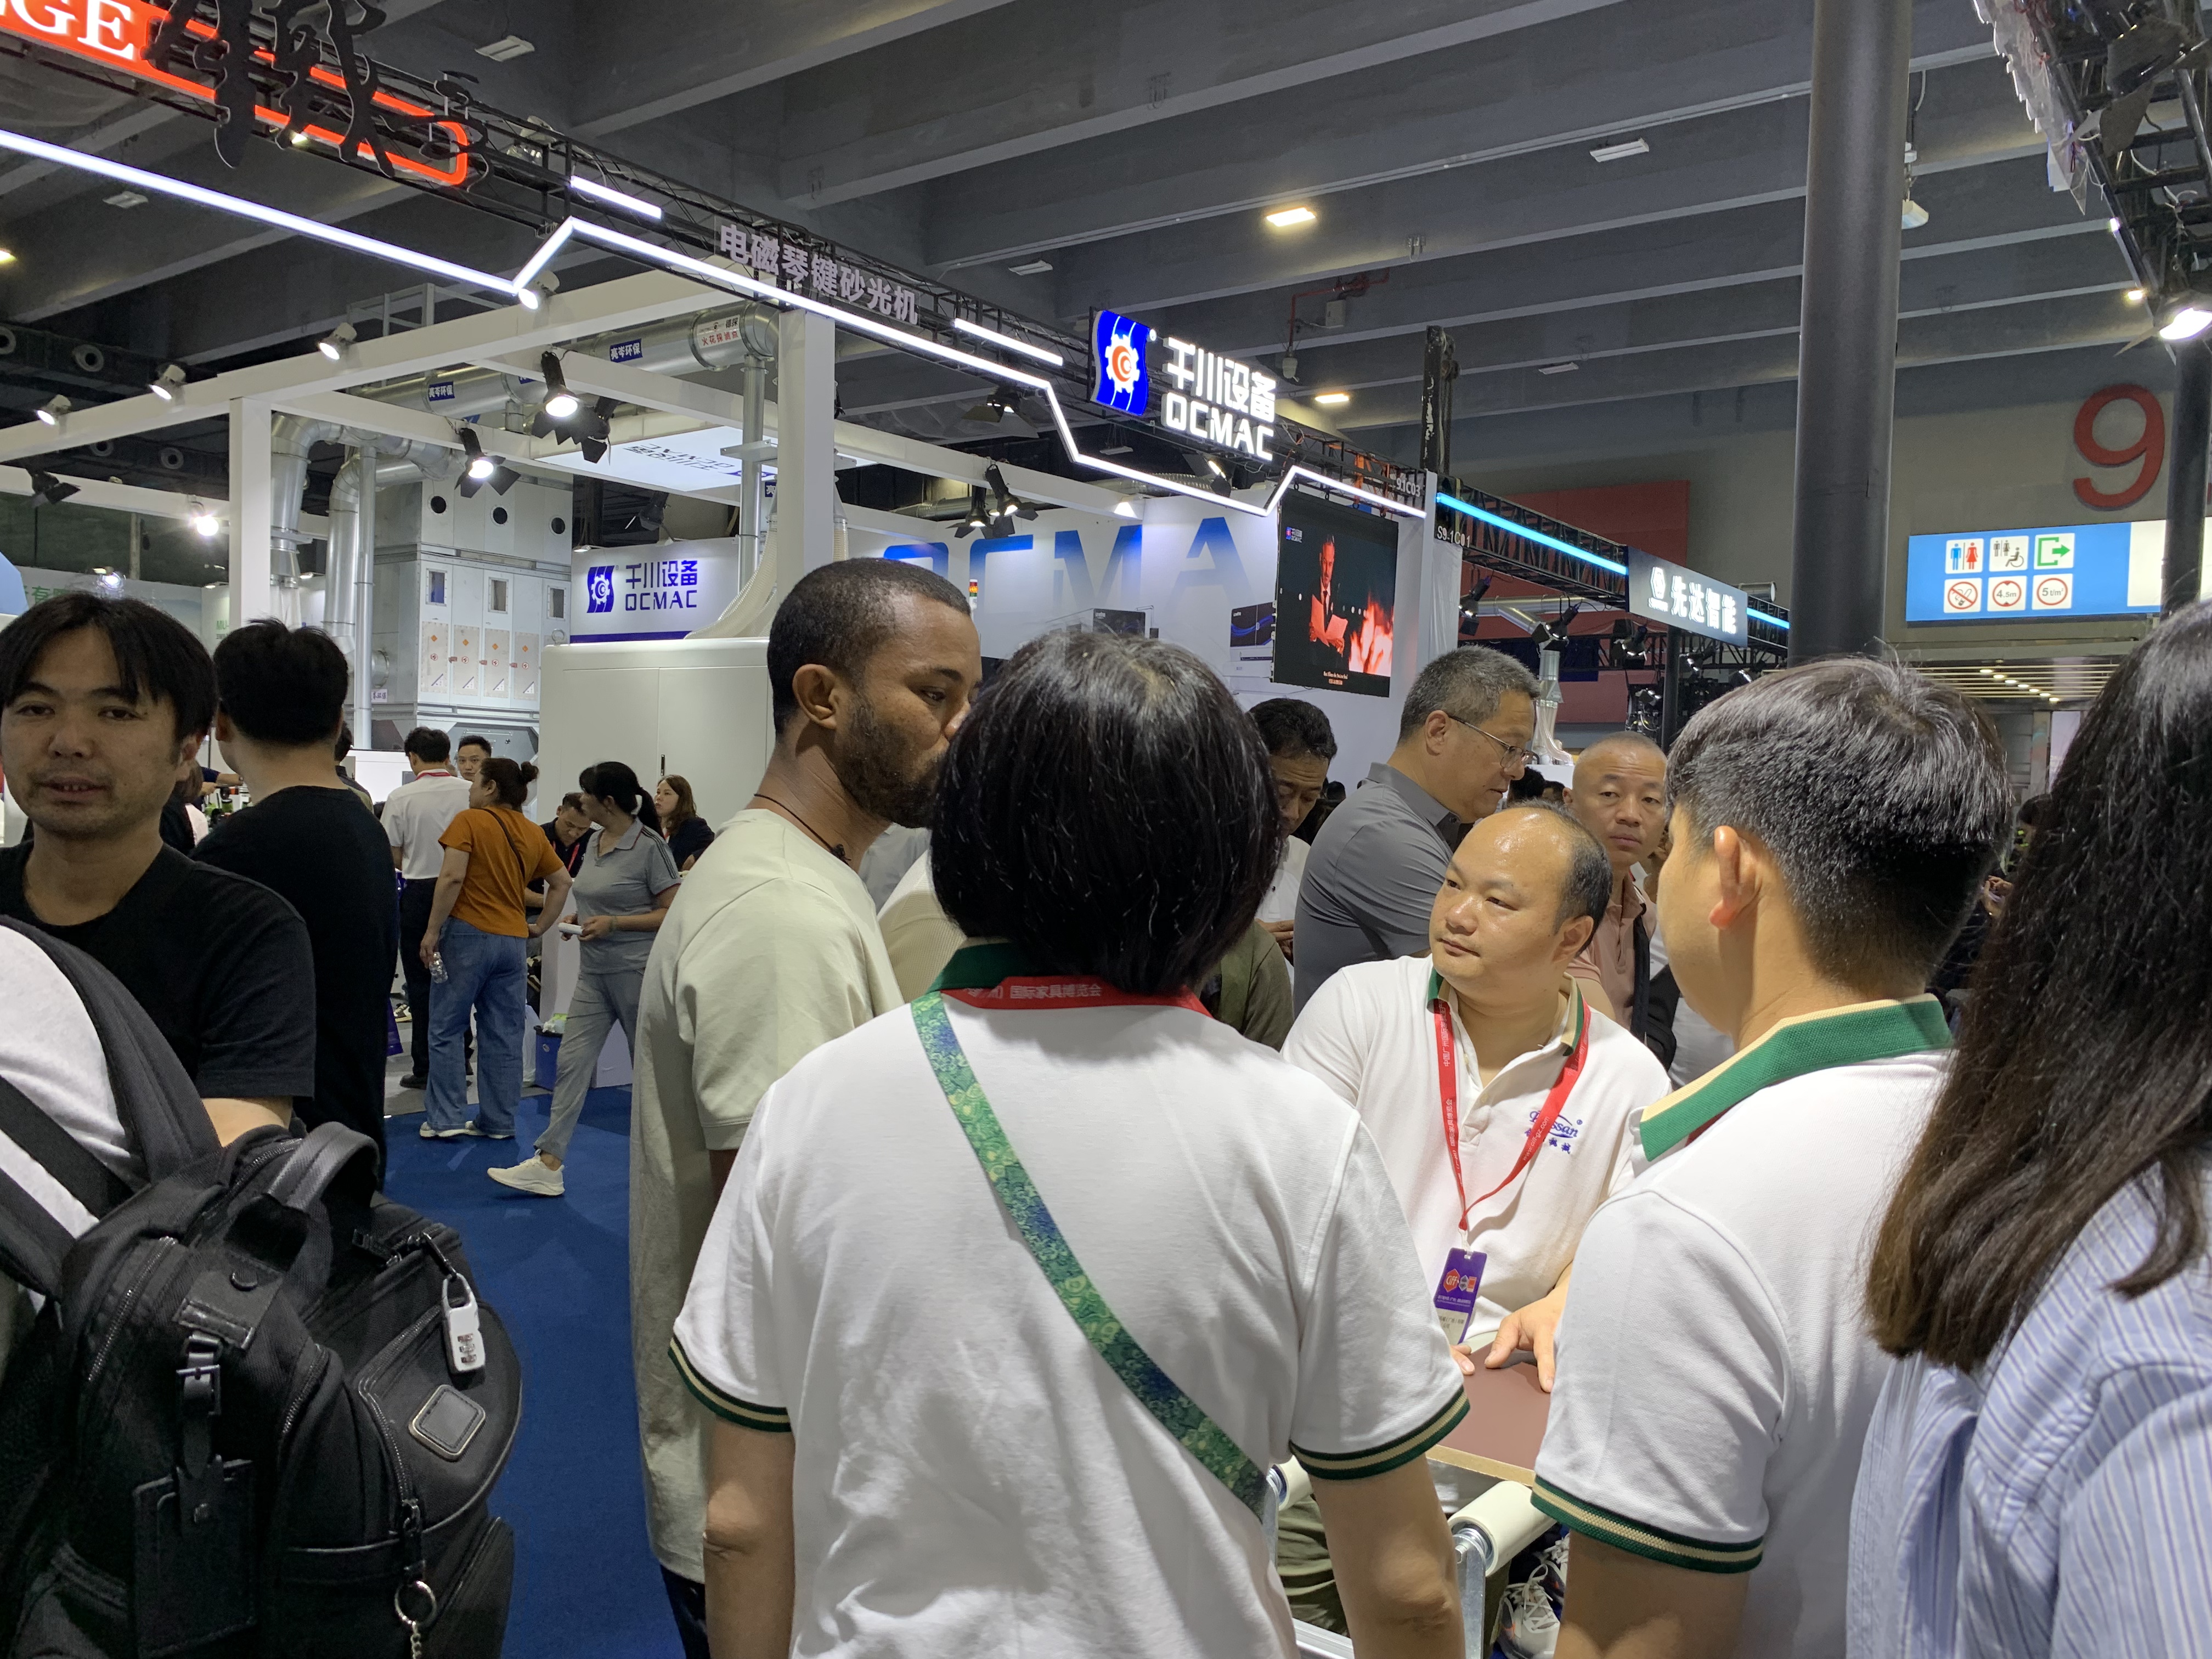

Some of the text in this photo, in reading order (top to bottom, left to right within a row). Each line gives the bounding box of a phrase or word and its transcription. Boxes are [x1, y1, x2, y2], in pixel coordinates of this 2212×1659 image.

[0, 0, 134, 59] GE
[720, 224, 918, 325] 电磁琴键砂光机
[1166, 337, 1276, 422] 千川设备
[1165, 392, 1274, 461] QCMAC
[626, 560, 697, 589] 千川设备
[1996, 590, 2017, 598] 4.5m
[2042, 588, 2049, 596] 5
[625, 590, 697, 611] QCMAC
